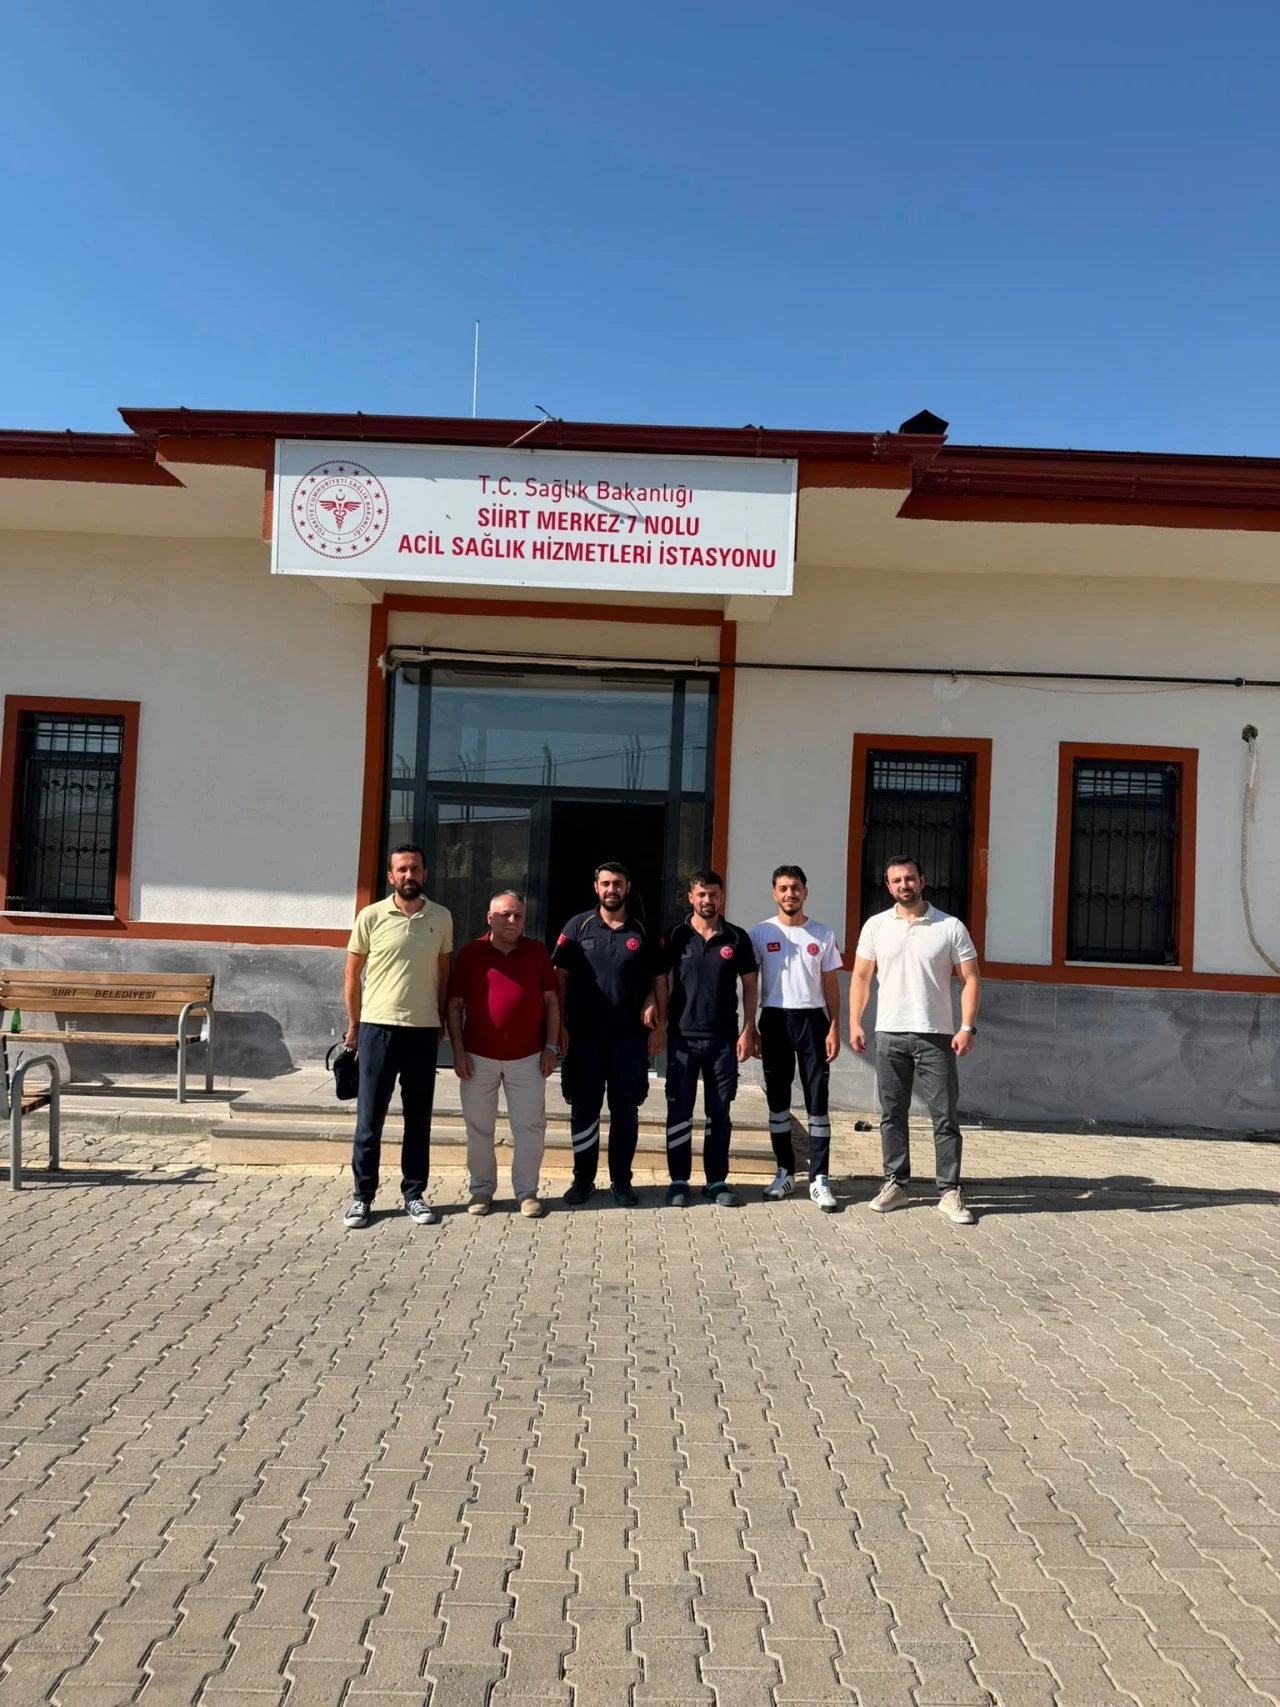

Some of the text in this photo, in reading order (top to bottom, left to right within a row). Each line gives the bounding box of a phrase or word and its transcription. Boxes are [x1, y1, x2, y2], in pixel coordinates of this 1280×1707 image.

[349, 480, 368, 500] SAĞLIK
[478, 474, 693, 508] T.C. Sağlık Bakanlığı
[477, 503, 700, 536] SİİRT MERKEZ 7 NOLU
[398, 531, 777, 569] ACİL SAĞLIK HİZMETLERİ İSTASYONU
[94, 989, 156, 999] BELEDİYESİ
